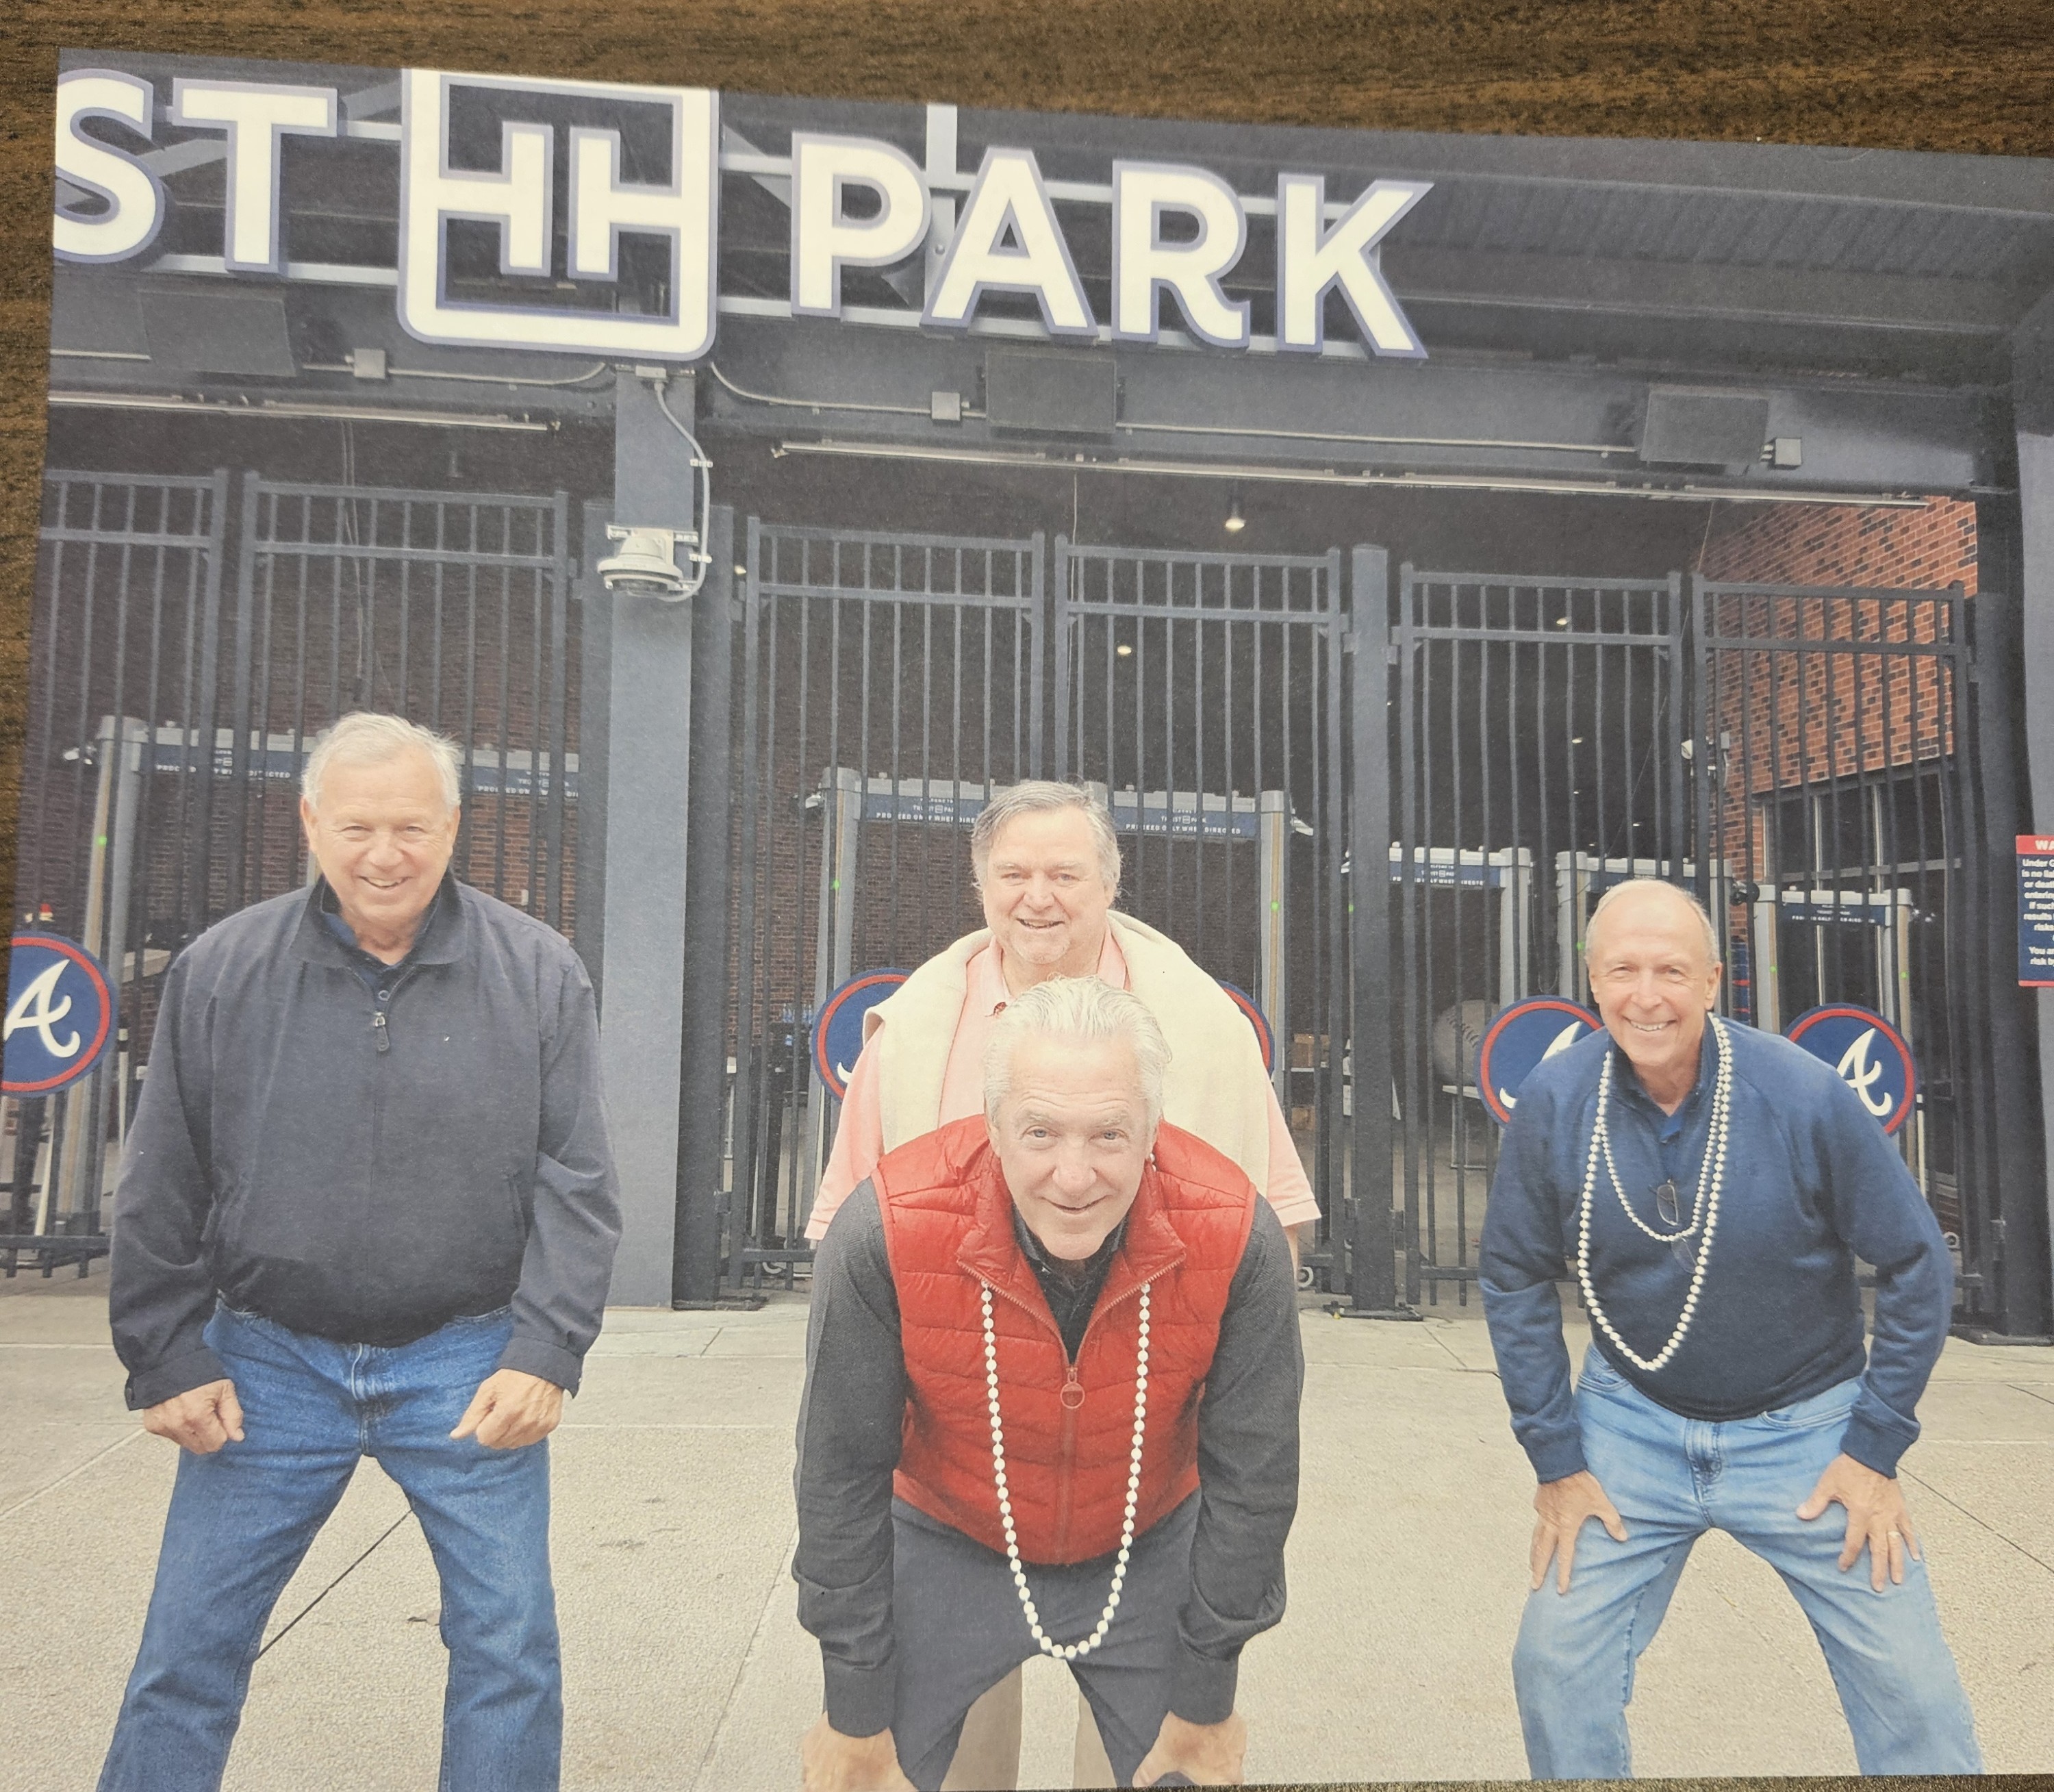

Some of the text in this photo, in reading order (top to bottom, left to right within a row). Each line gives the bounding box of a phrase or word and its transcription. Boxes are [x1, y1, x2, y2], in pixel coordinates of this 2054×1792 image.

[792, 131, 1435, 359] PARK
[876, 812, 911, 820] PROEED
[1126, 823, 1161, 832] PREED
[1204, 826, 1241, 834] DIRECED
